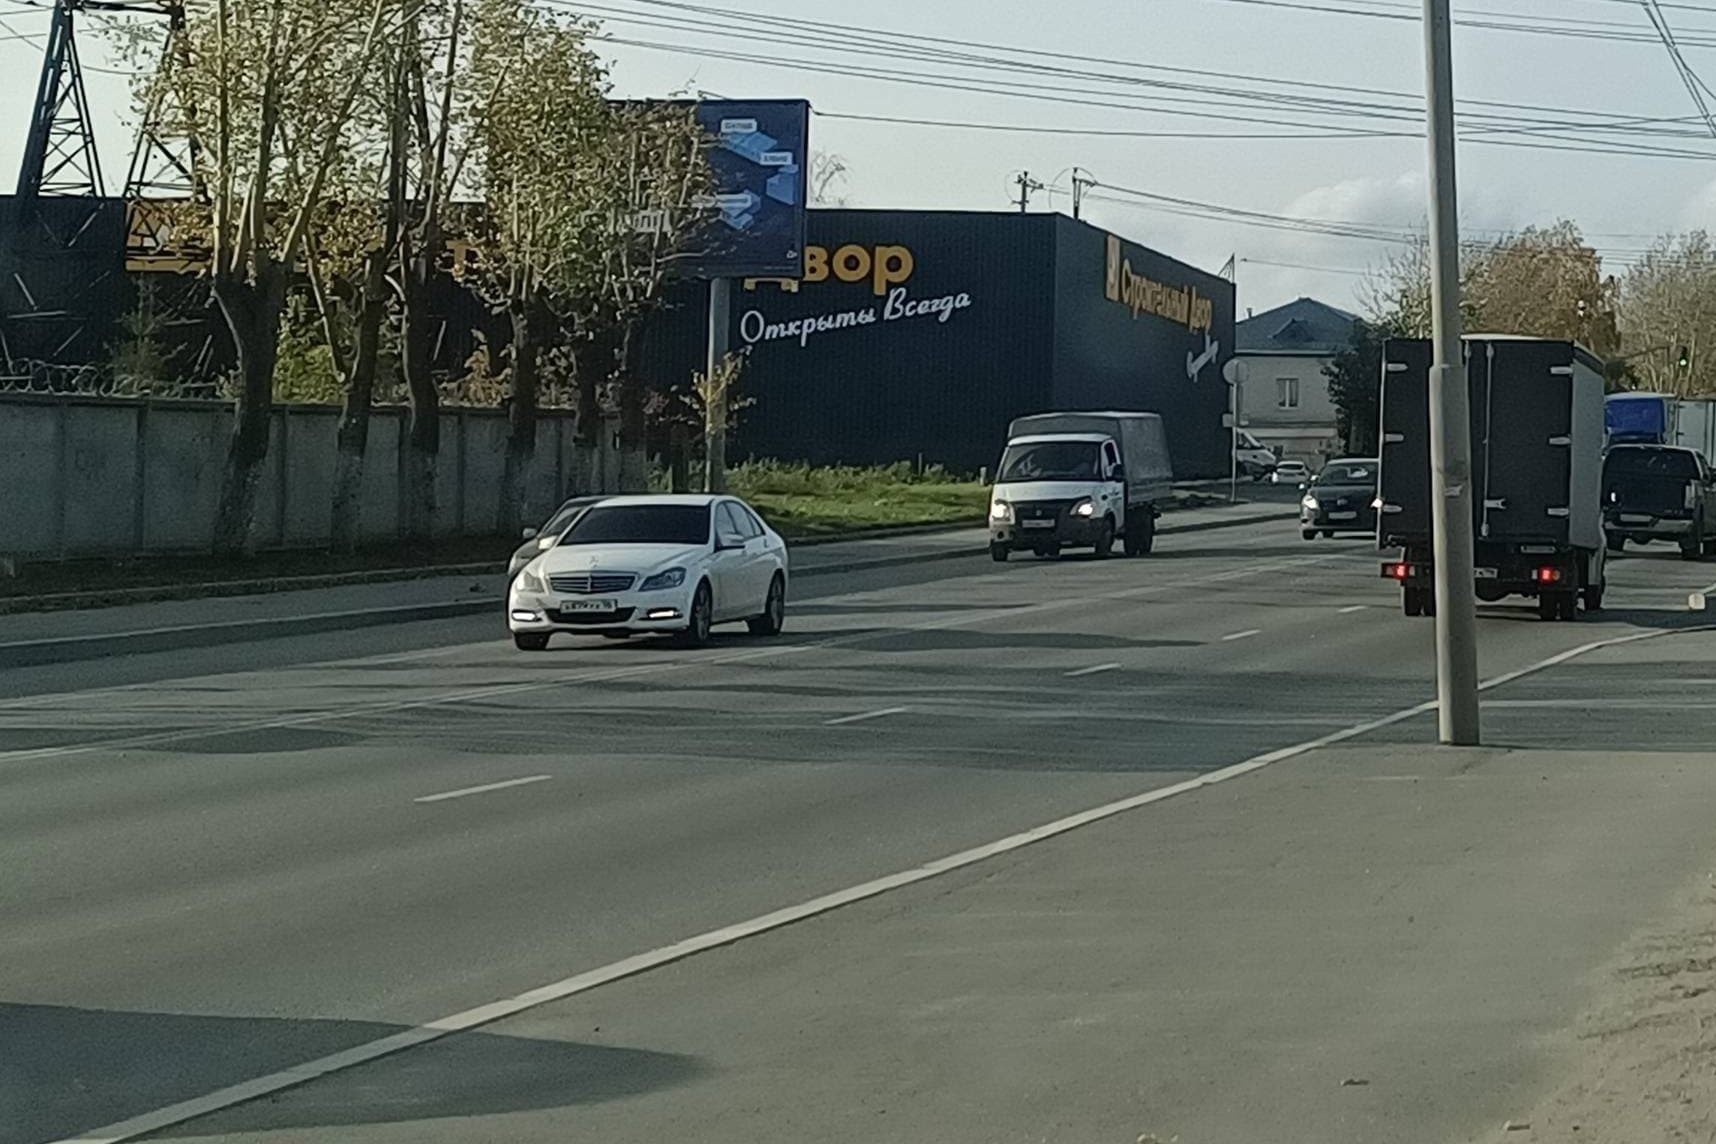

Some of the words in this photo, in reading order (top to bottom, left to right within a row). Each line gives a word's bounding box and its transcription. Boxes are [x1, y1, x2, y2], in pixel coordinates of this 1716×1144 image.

[744, 244, 914, 296] вор
[740, 306, 876, 347] Открыты
[883, 287, 972, 322] Всегда
